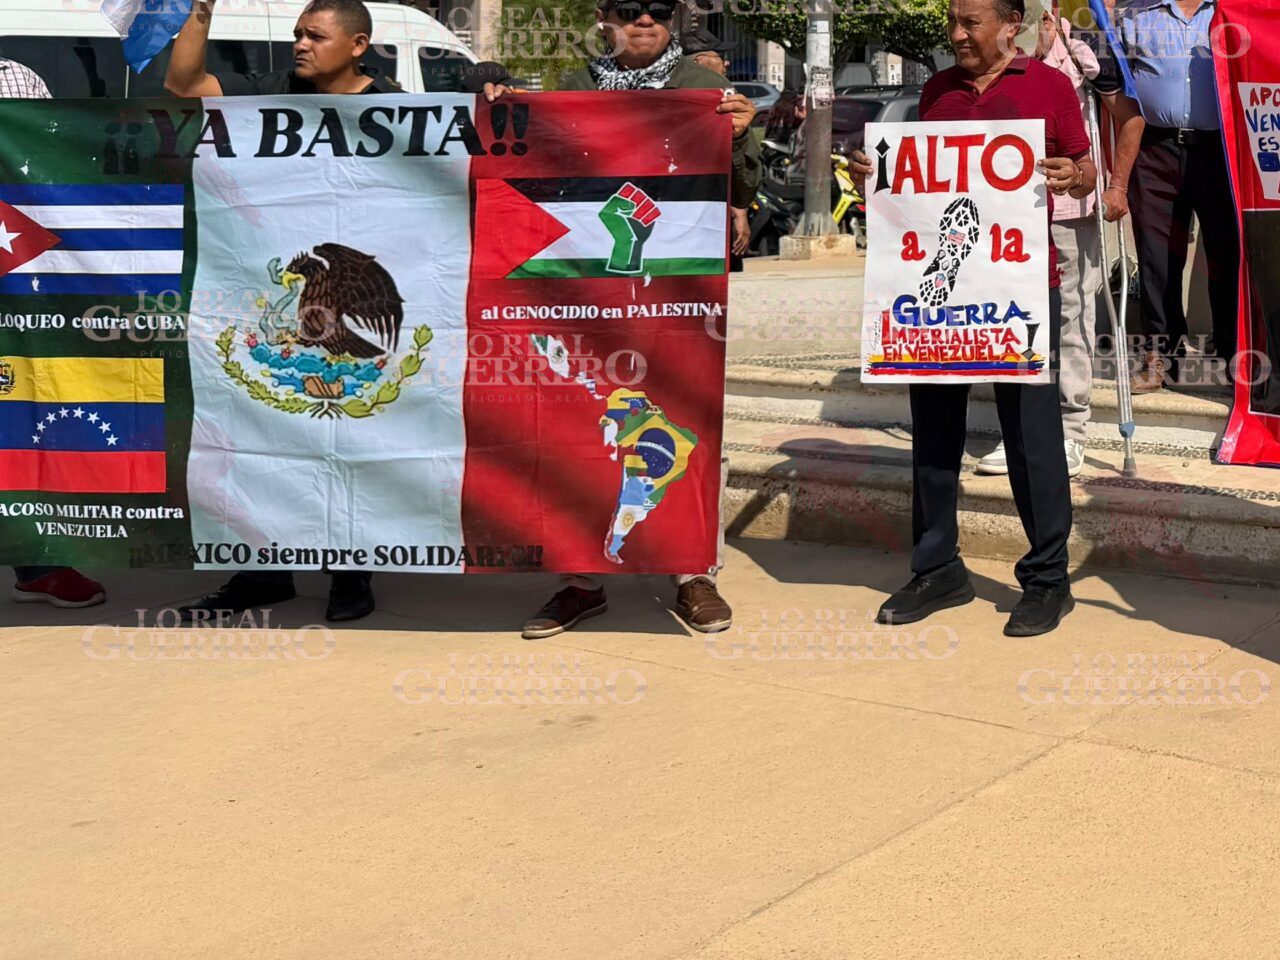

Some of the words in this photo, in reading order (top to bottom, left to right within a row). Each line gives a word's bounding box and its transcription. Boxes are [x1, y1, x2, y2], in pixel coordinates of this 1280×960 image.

[254, 103, 529, 159] BASTA!!
[1258, 137, 1280, 152] ES
[874, 134, 1035, 195] ¡ALTO
[901, 230, 927, 261] a
[990, 223, 1030, 263] la
[72, 316, 131, 330] contra
[134, 314, 187, 331] CUBA
[481, 306, 499, 320] al
[502, 304, 600, 320] GENOCIDIO
[602, 307, 623, 319] en
[626, 302, 724, 319] PALESTINA
[892, 294, 1034, 327] GUERRA
[881, 309, 1023, 346] IMPERIALISTA
[884, 343, 902, 362] EN
[56, 504, 123, 519] MILITAR
[126, 505, 185, 519] contra
[35, 521, 129, 538] VENEZUELA
[257, 542, 368, 574] siempre
